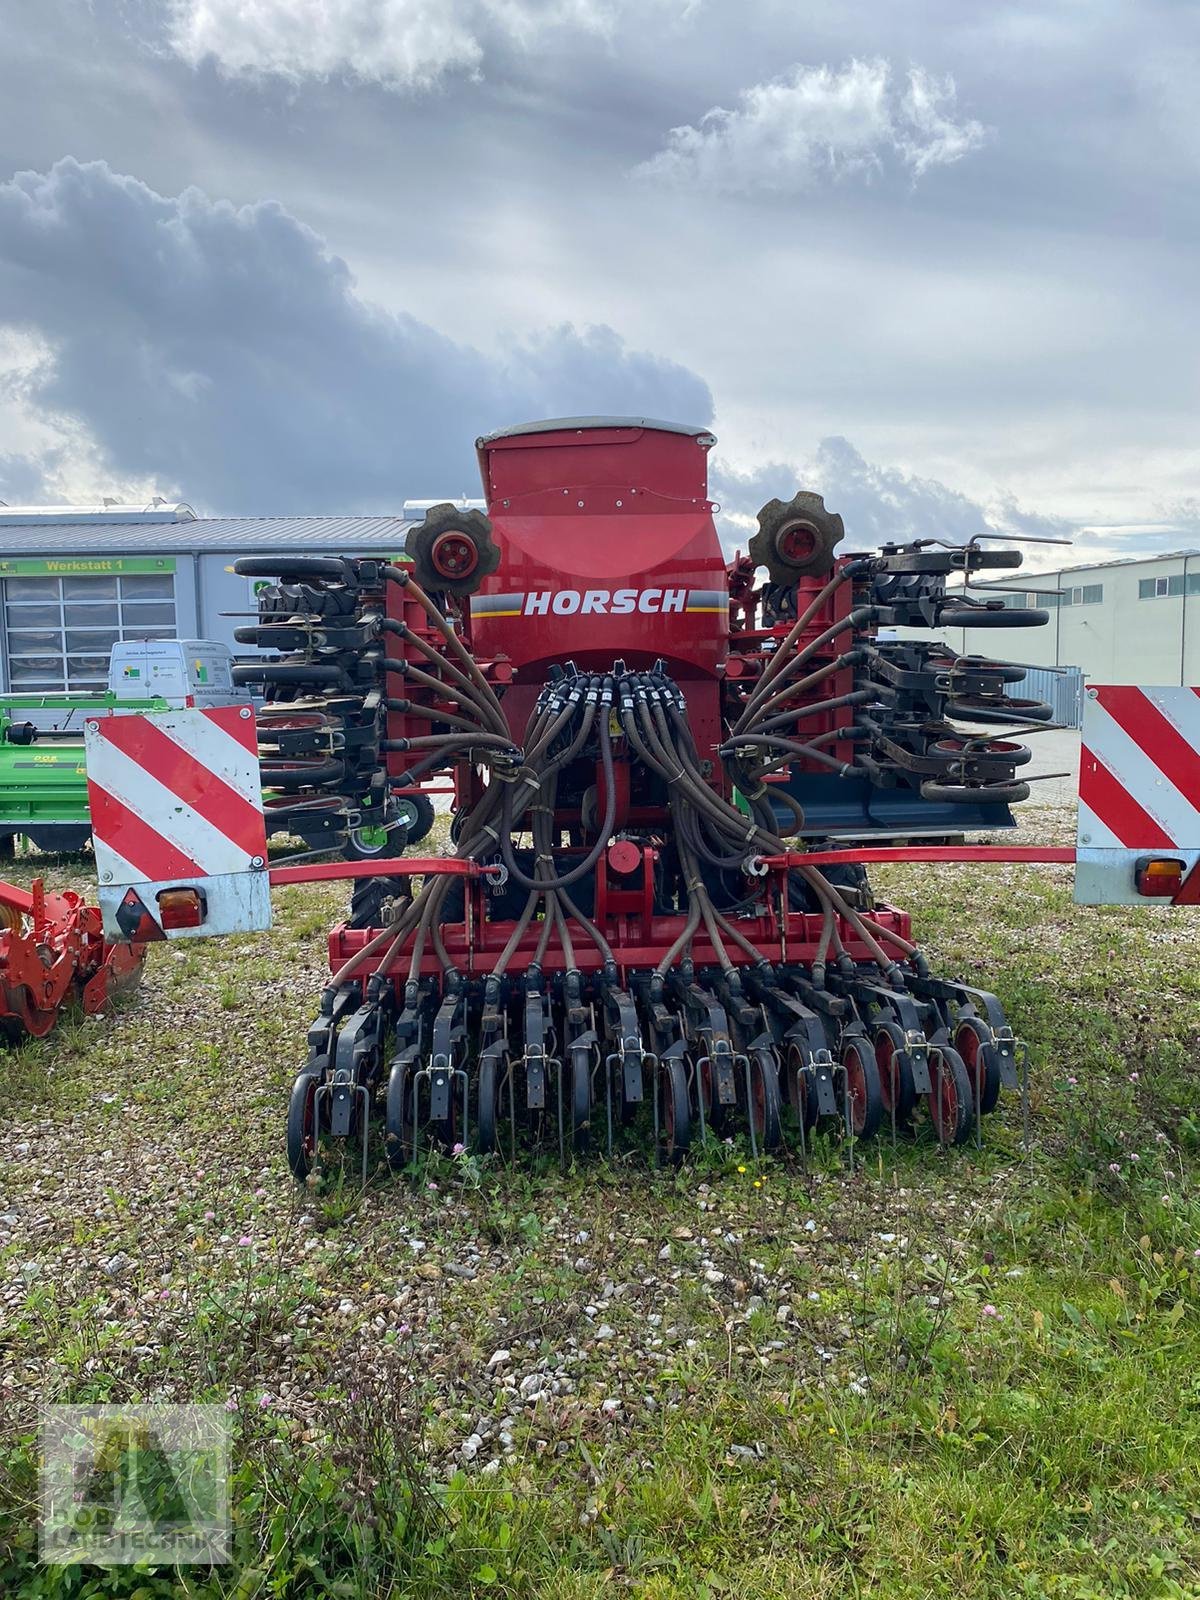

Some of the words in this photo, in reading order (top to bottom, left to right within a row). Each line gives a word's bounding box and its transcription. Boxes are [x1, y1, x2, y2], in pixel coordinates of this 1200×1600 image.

[46, 560, 112, 571] Werkstatt
[116, 560, 123, 570] 1
[524, 588, 687, 616] HORSCH
